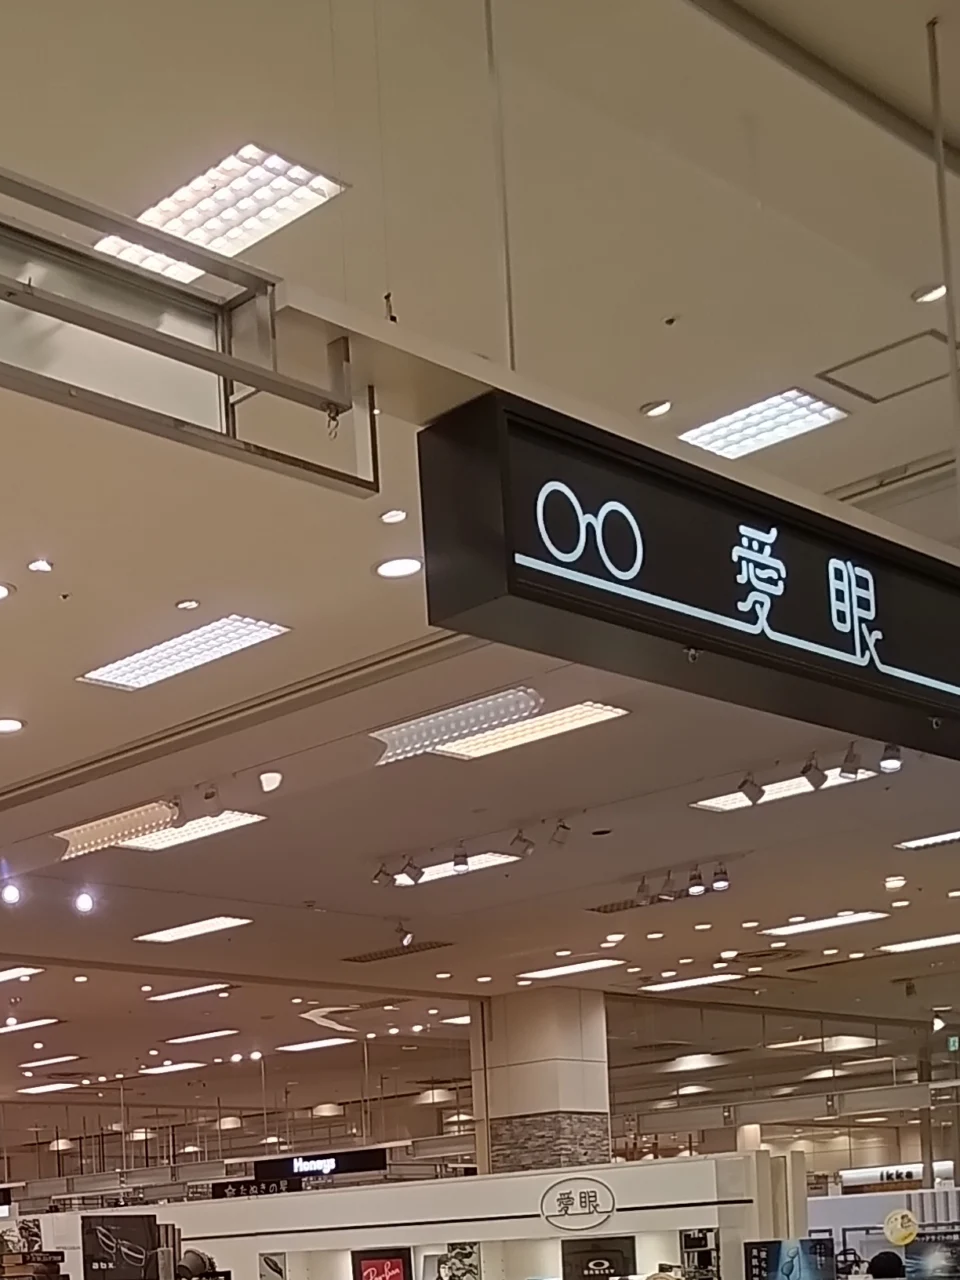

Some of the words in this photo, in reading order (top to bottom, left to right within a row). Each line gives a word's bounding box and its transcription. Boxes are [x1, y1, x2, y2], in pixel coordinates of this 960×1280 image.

[732, 524, 883, 665] 愛眼
[293, 1157, 336, 1174] Honeys
[879, 1170, 913, 1181] ikka
[556, 1190, 601, 1215] 愛眼
